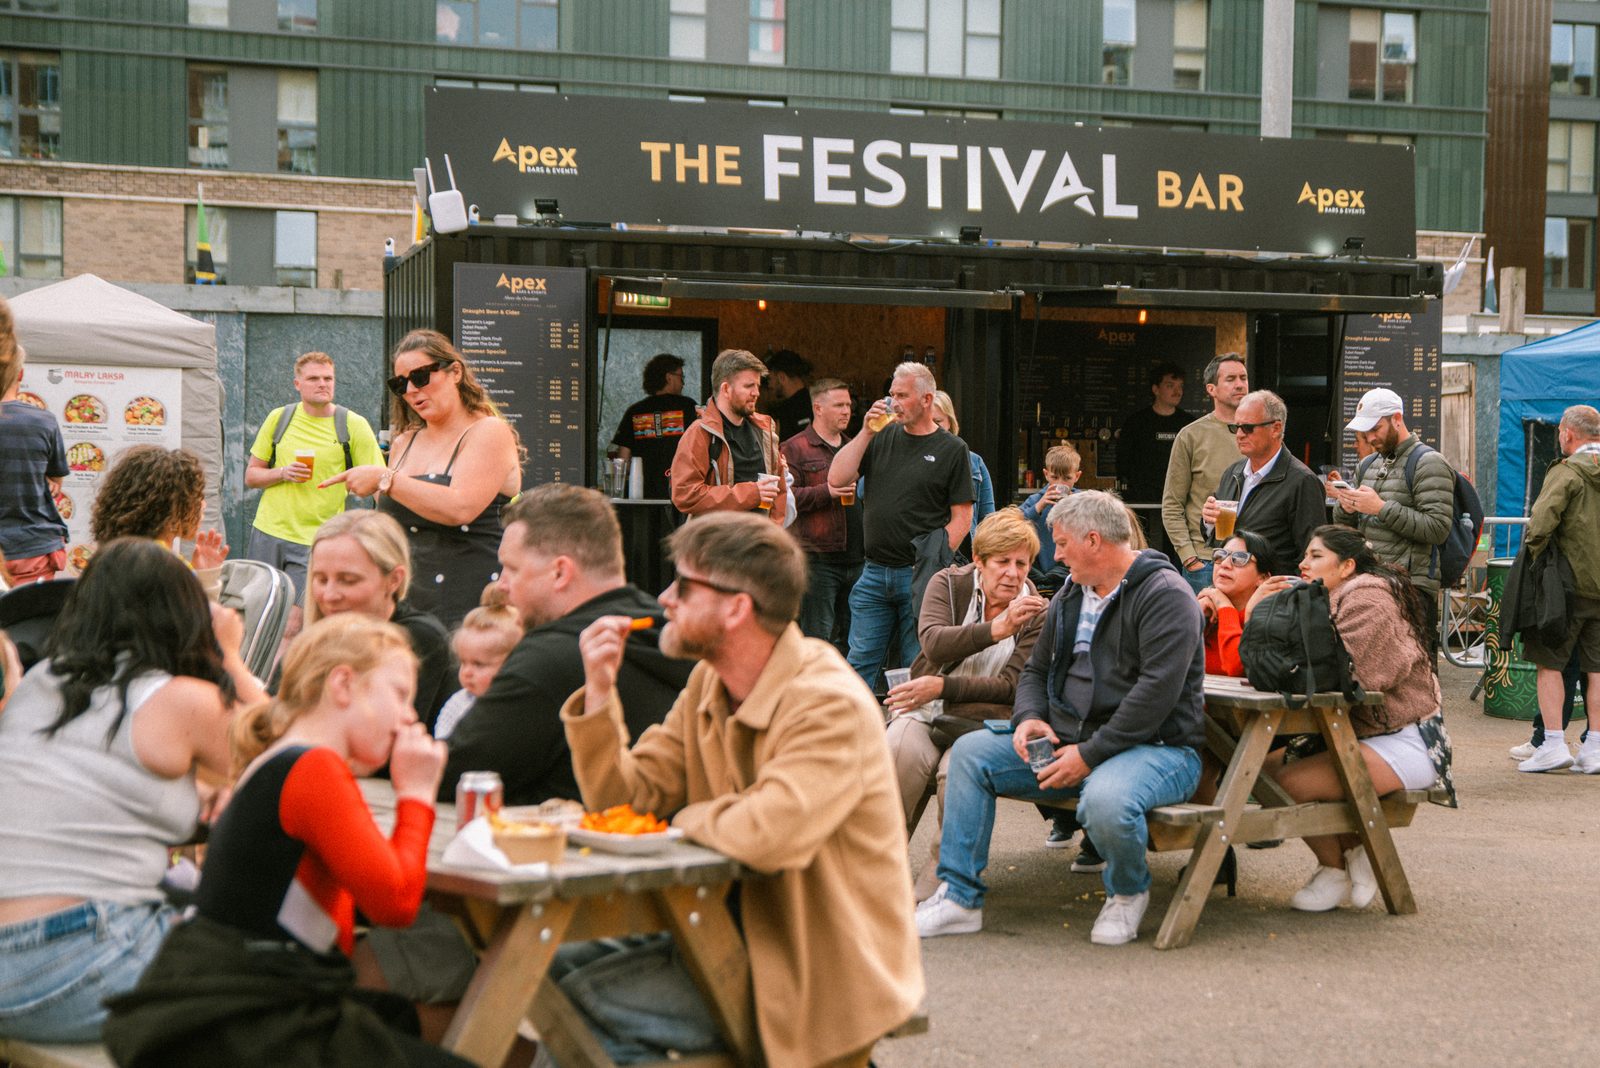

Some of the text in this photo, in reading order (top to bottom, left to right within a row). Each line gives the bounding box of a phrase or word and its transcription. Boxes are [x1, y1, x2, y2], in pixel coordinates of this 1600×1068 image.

[492, 137, 578, 173] Apex
[640, 134, 1245, 219] THE FESTIVAL BAR
[1297, 181, 1365, 214] Apex
[496, 272, 547, 294] Apex
[1097, 328, 1136, 344] Apex
[64, 370, 125, 380] MALAY LAKSA
